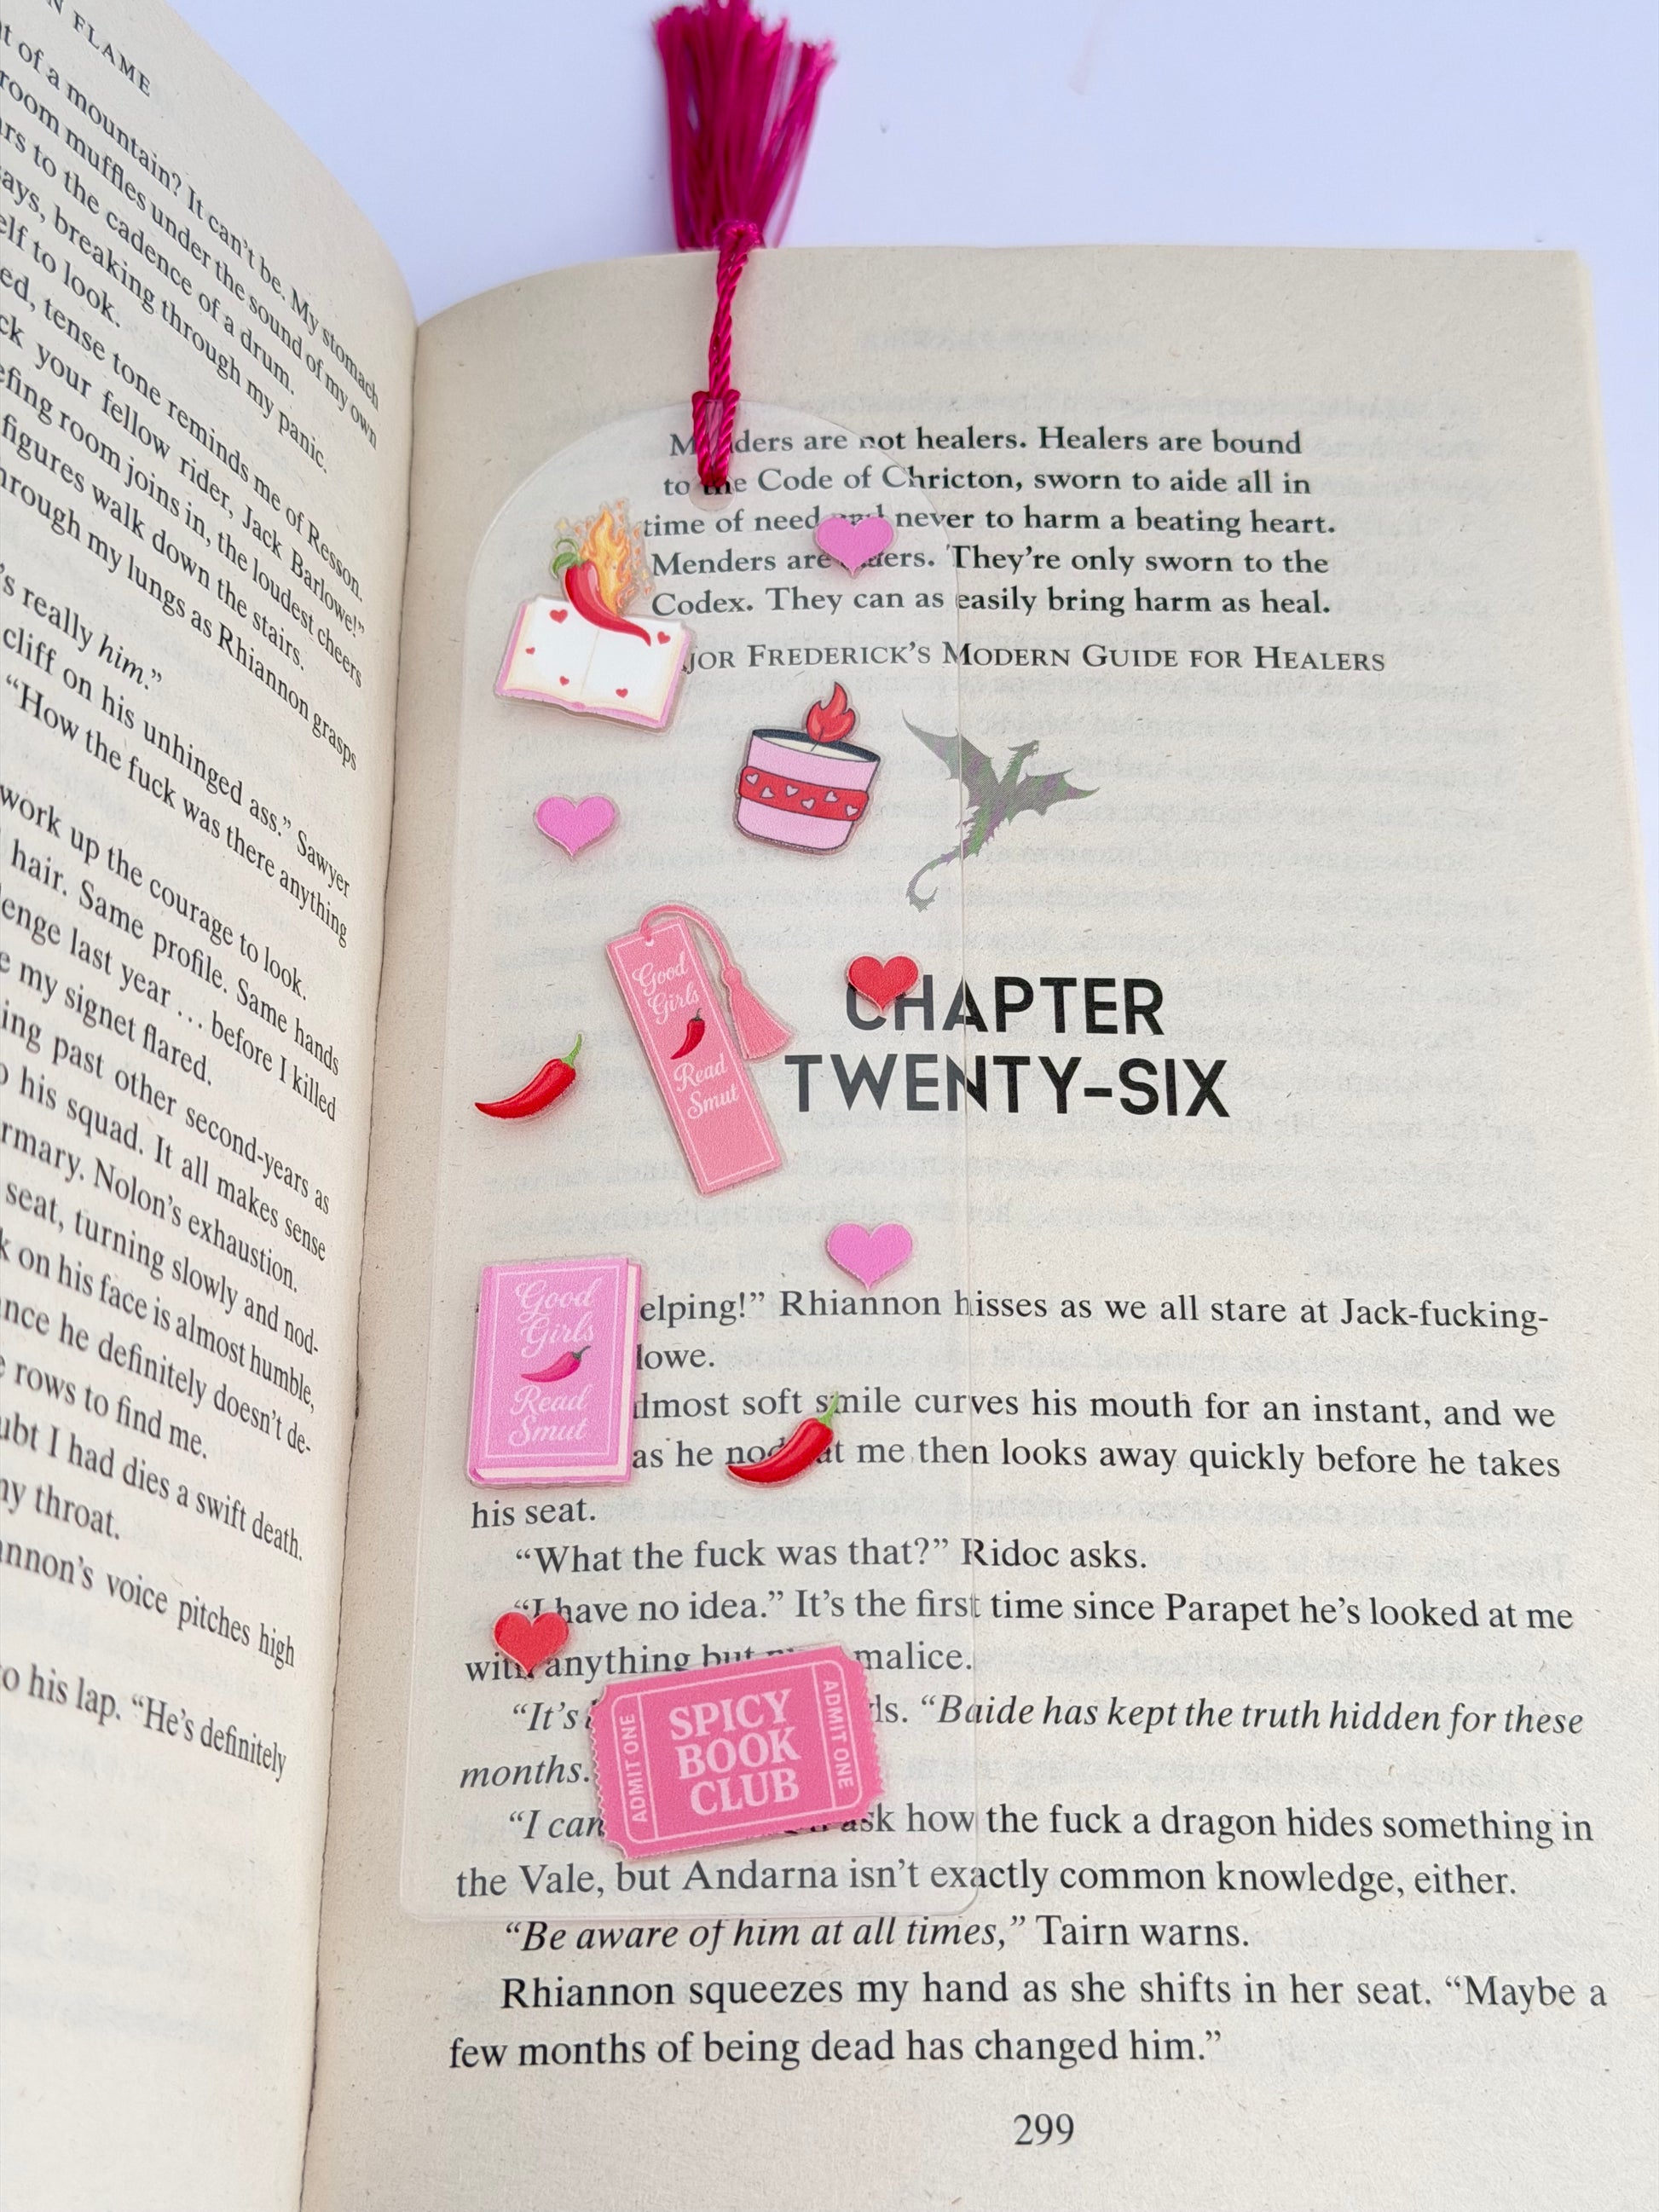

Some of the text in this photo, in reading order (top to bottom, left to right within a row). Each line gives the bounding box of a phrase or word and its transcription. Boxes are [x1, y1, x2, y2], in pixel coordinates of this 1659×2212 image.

[72, 9, 152, 98] FLAME
[18, 41, 380, 412] of a mountain? It can’t be. My stomach
[669, 424, 1303, 457] Mders are not healers. Healers are bound
[663, 477, 690, 496] to
[758, 465, 833, 492] Code
[843, 465, 872, 489] of
[882, 465, 1023, 493] Chricton,
[1034, 473, 1122, 490] sworn
[1131, 471, 1160, 491] to
[1170, 467, 1228, 493] aide
[1237, 469, 1273, 494] all
[1283, 471, 1311, 494] in
[1, 413, 306, 672] figures walk down the stairs.
[644, 514, 705, 537] time
[715, 508, 744, 533] of
[754, 505, 821, 532] need
[895, 512, 975, 528] never
[985, 510, 1014, 528] to
[1022, 504, 1101, 529] harm
[1110, 514, 1126, 530] a
[1135, 505, 1241, 539] beating
[1249, 508, 1335, 534] heart.
[651, 585, 1331, 618] Codex. They can as easily bring harm as heal.
[21, 585, 163, 691] really him.”
[747, 640, 931, 667] FREDERICK’S
[941, 641, 1071, 667] MODERN
[1082, 644, 1178, 667] GUIDE
[1188, 650, 1243, 668] FOR
[1252, 645, 1385, 672] HEALERS
[0, 783, 307, 1002] work up the courage to look.
[632, 951, 689, 996] Good
[647, 982, 700, 1025] Girls
[673, 1053, 727, 1092] Read
[784, 1053, 1231, 1118] TWENTY-SIX
[687, 1083, 739, 1119] Smut
[5, 1181, 320, 1357] seat, turning slowly and nod-
[515, 1276, 602, 1323] Good
[779, 1289, 942, 1317] Rhiannon
[954, 1289, 1048, 1318] hisses
[1061, 1299, 1092, 1319] as
[1104, 1300, 1147, 1320] we
[1160, 1294, 1199, 1321] all
[1211, 1298, 1287, 1323] stare
[1300, 1300, 1329, 1324] at
[1340, 1297, 1549, 1337] Jack-fucking-
[520, 1311, 594, 1359] Girls
[14, 1363, 208, 1461] rows to find me.
[510, 1383, 592, 1416] Read
[743, 1387, 803, 1416] soft
[816, 1386, 901, 1417] smile
[915, 1394, 1019, 1416] curves
[1032, 1388, 1078, 1417] his
[1089, 1390, 1194, 1418] mouth
[1204, 1391, 1250, 1420] for
[1263, 1401, 1302, 1421] an
[1313, 1394, 1431, 1429] instant,
[1443, 1399, 1502, 1426] and
[1512, 1407, 1556, 1428] we
[507, 1415, 589, 1447] Smut
[471, 1498, 596, 1529] his seat.
[516, 1537, 1147, 1574] “What the fuck was that?” Ridoc asks.
[27, 1662, 287, 1783] his lap. “He’s definitely
[512, 1701, 579, 1731] “It’s
[668, 1688, 793, 1741] SPICY
[821, 1678, 854, 1790] ADMIT ONE
[921, 1694, 1035, 1724] “Baide
[1042, 1695, 1099, 1725] has
[1107, 1695, 1178, 1735] kept
[1183, 1697, 1234, 1727] the
[1242, 1699, 1321, 1730] truth
[1329, 1700, 1441, 1731] hidden
[1446, 1702, 1497, 1740] for
[1505, 1704, 1584, 1735] these
[460, 1754, 590, 1788] months.
[619, 1712, 650, 1823] ADMIT ONE
[674, 1726, 802, 1780] BOOK
[690, 1767, 800, 1816] CLUB
[456, 1857, 1516, 1902] the Vale, but Andarna isn’t exactly common knowledge, either.
[448, 2028, 1222, 2071] few months of being dead has changed him.”
[1014, 2113, 1074, 2146] 299
